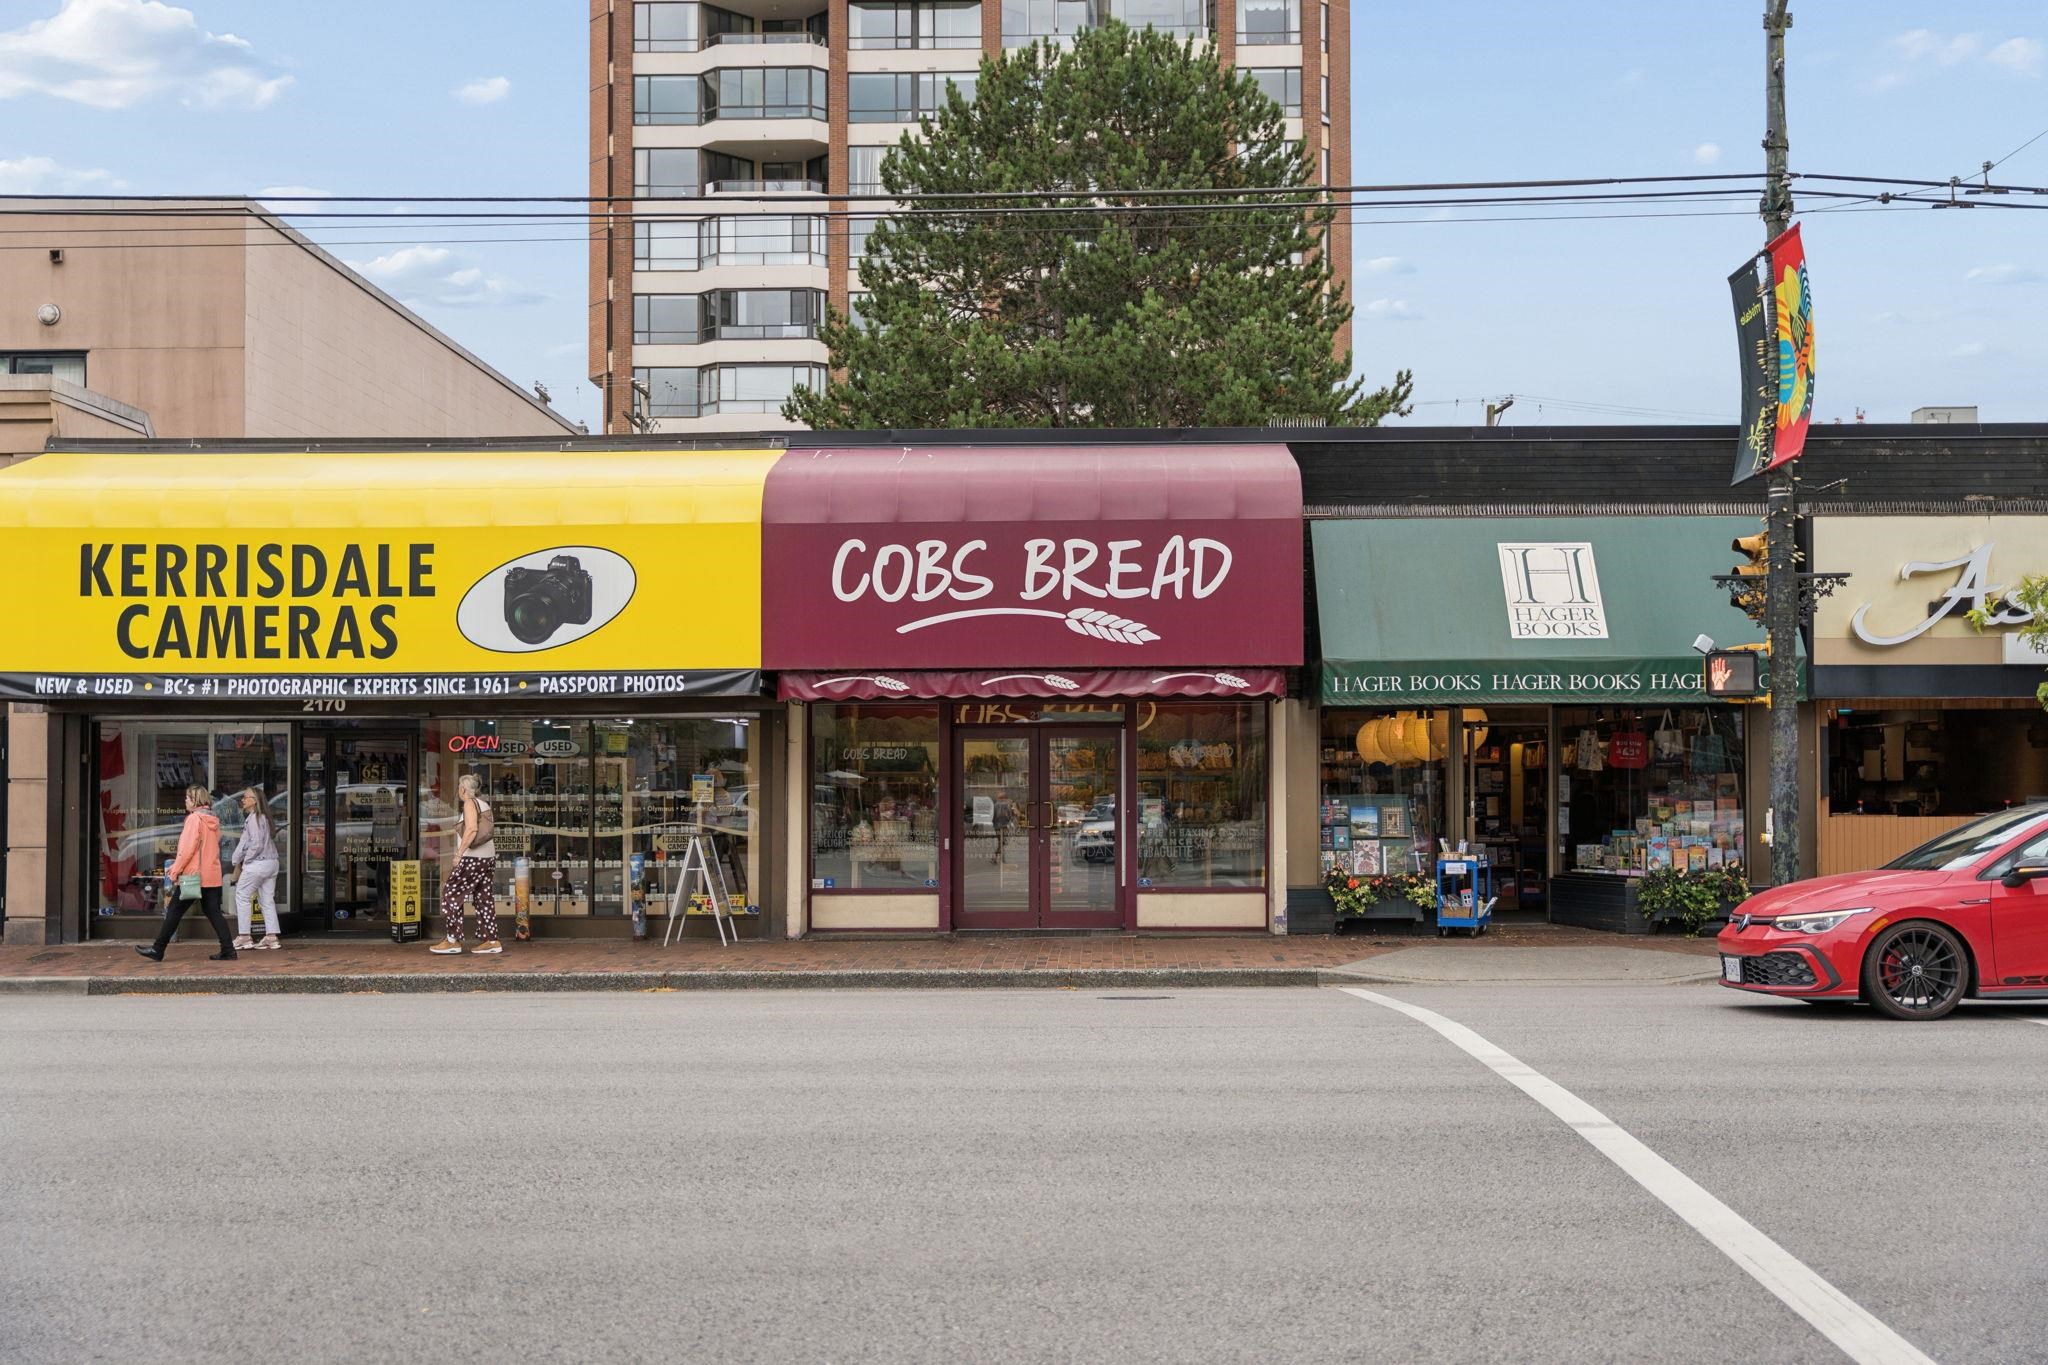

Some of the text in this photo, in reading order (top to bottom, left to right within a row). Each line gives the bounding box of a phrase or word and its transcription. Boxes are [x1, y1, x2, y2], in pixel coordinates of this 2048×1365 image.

[80, 543, 435, 599] KERRISDALE
[831, 534, 1233, 603] COBS BREAD
[1515, 607, 1599, 622] HAGER
[117, 604, 399, 659] CAMERAS
[1517, 621, 1601, 636] BOOKS
[35, 675, 684, 695] NEW & USED BC's #1 PHOTOGRAPHIC EXPERTS SINCE 1961 PASSPORT PHOTOS
[1333, 672, 1706, 692] HAGER BOOKS HAGER BOOKS HAGE
[303, 699, 346, 712] 2170
[448, 735, 500, 753] OPEN
[543, 741, 572, 751] USED
[843, 748, 908, 760] COBS BREAD
[362, 765, 380, 779] 65
[156, 807, 186, 815] Trade-ins
[647, 805, 675, 813] Olympus
[1148, 829, 1177, 837] FREH
[818, 839, 847, 848] DELIGHT
[1148, 838, 1193, 846] FRENCH
[343, 847, 371, 855] Digital
[1148, 846, 1193, 858] BAGUETTE
[349, 855, 393, 863] Specialists
